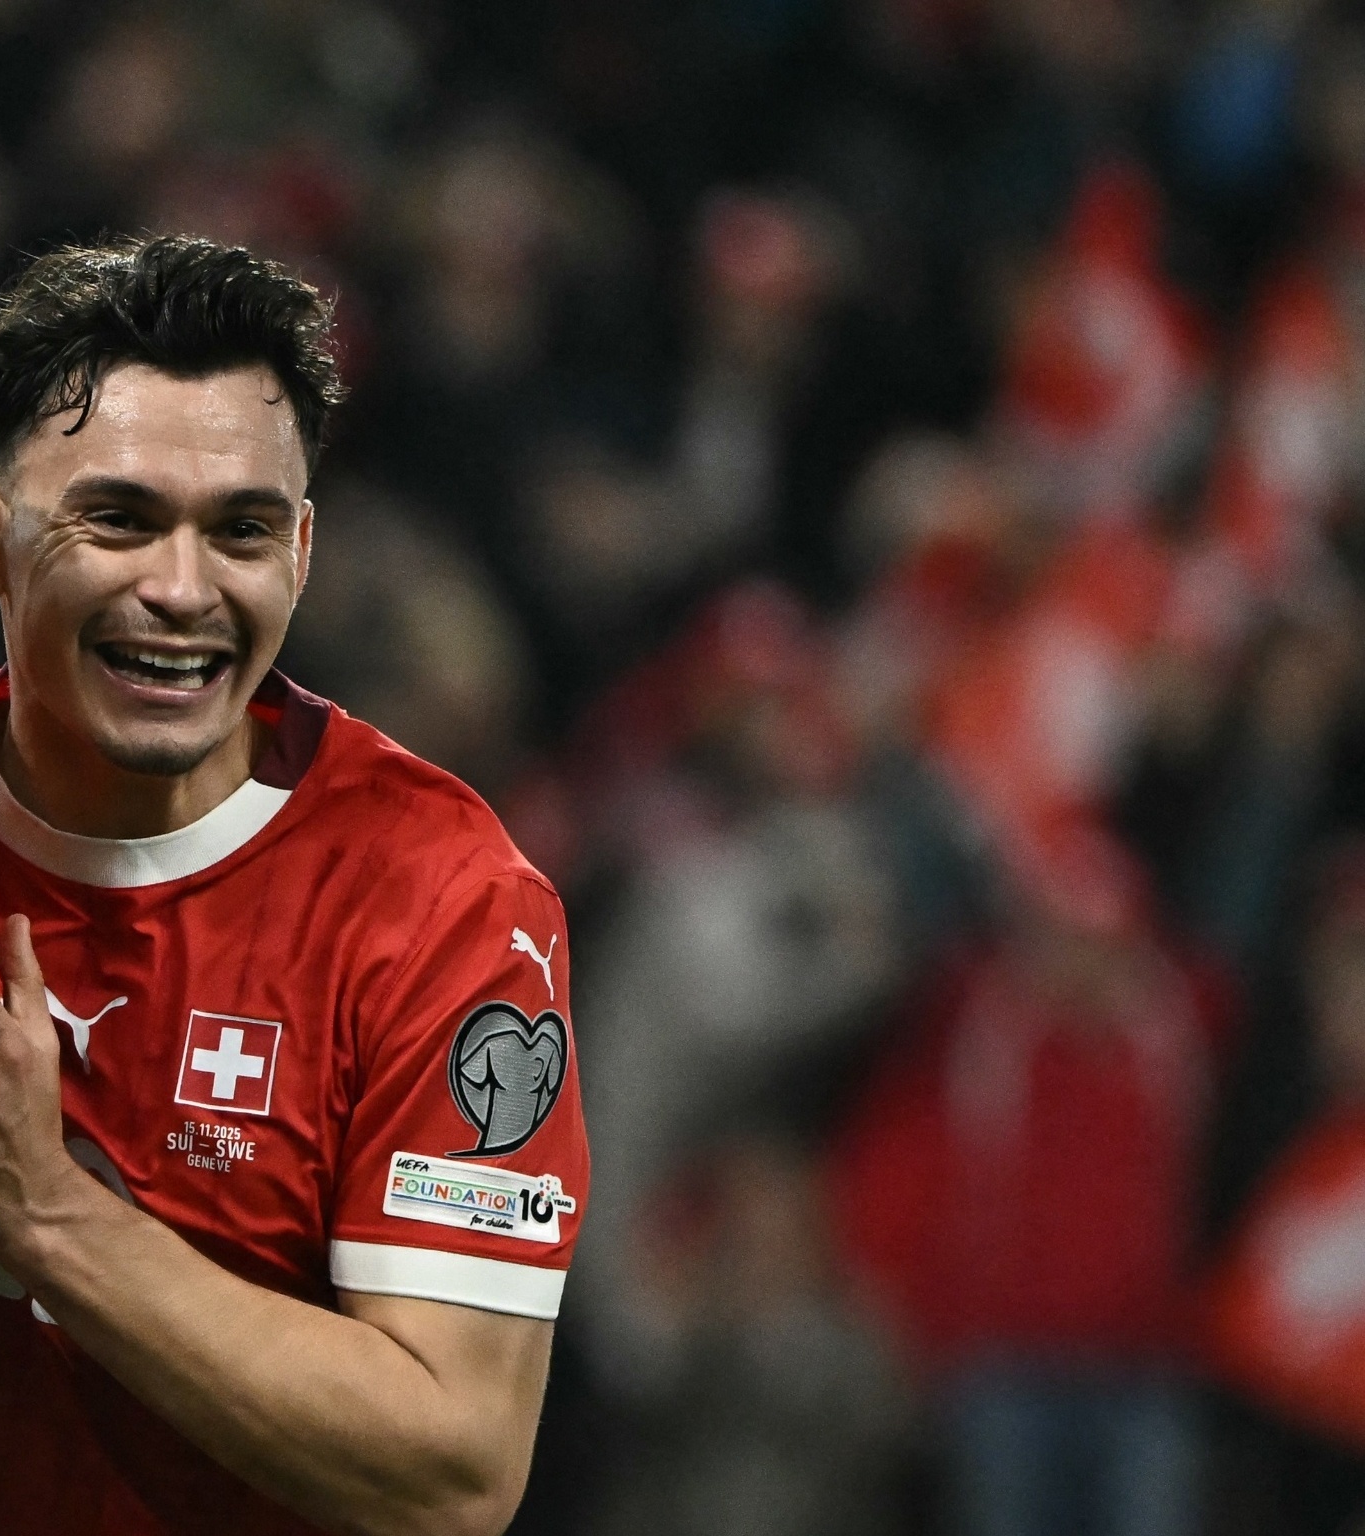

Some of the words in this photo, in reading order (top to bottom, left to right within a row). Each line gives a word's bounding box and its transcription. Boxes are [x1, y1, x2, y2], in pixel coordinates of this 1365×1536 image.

[184, 1121, 241, 1140] 15.11.2025
[167, 1132, 193, 1152] SUI
[215, 1139, 256, 1161] SWE
[187, 1153, 232, 1173] GENEVE
[396, 1157, 430, 1172] UEFA
[519, 1188, 554, 1224] 10
[553, 1199, 573, 1209] YEARS
[469, 1213, 484, 1226] for
[485, 1217, 514, 1231] children
